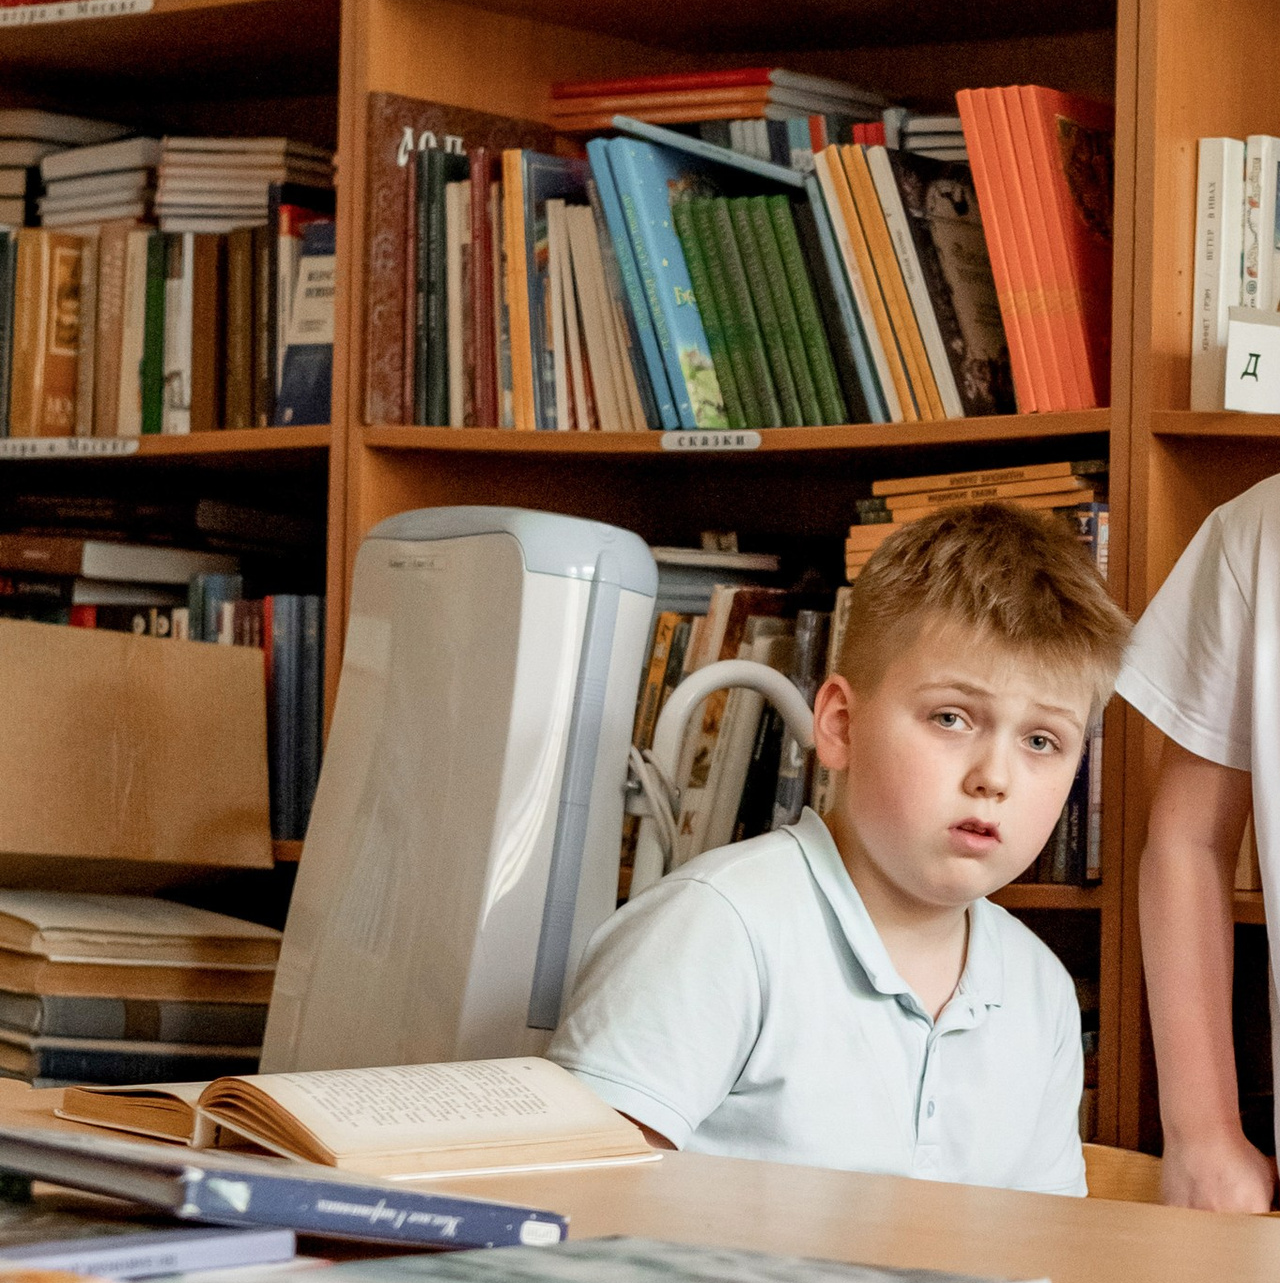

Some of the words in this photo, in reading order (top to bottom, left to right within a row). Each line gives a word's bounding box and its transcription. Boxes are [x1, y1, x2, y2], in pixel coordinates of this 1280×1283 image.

[1207, 181, 1216, 209] ИВАХ
[1204, 229, 1214, 261] ВЕТЕР
[1240, 352, 1261, 381] Д
[677, 434, 747, 447] сказки
